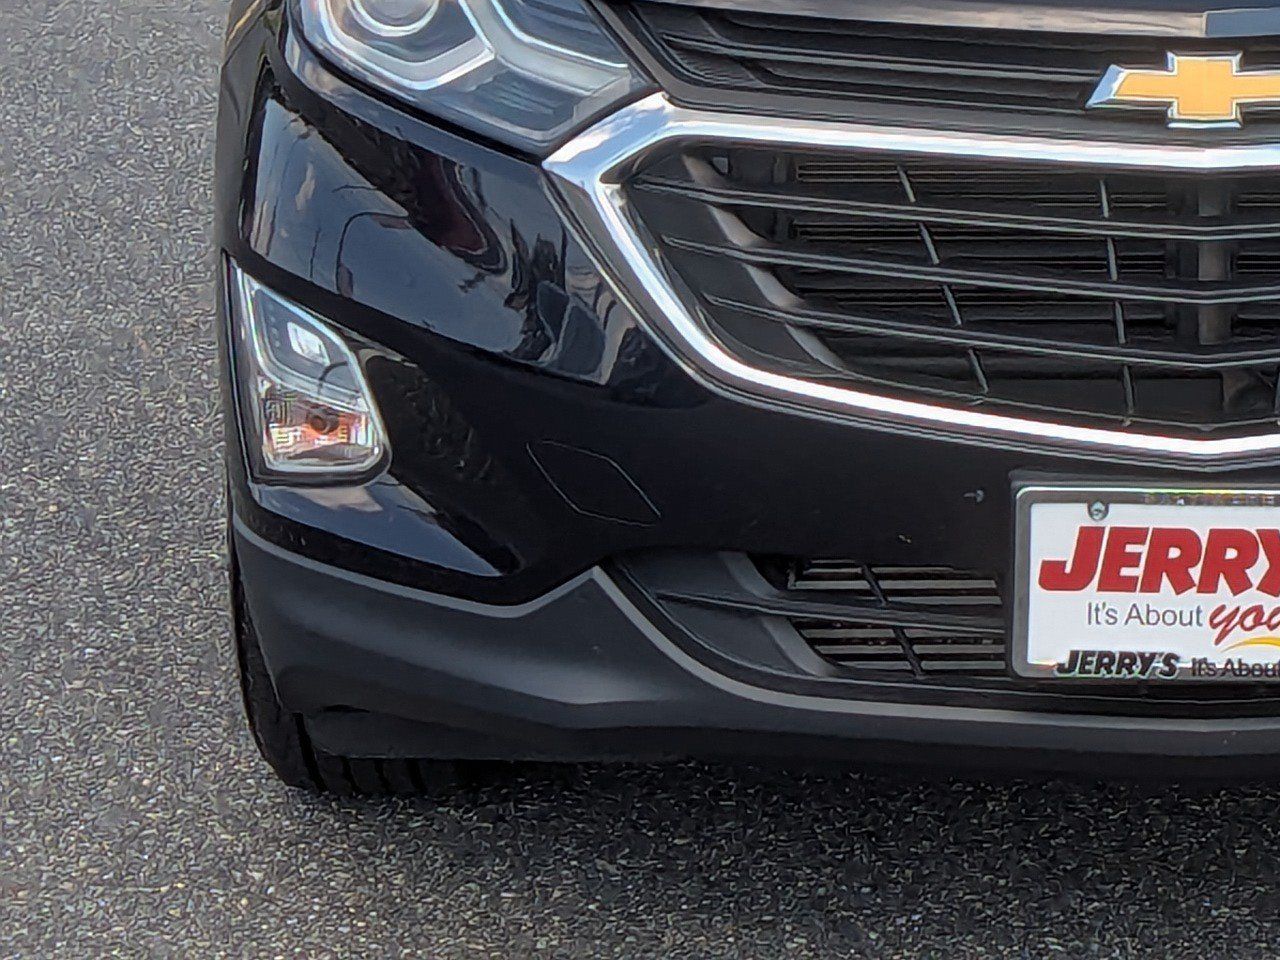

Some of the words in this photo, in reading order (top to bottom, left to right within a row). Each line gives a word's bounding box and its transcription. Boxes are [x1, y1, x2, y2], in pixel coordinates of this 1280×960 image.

[1086, 602, 1118, 626] It's
[1124, 602, 1203, 627] About
[1056, 650, 1181, 677] JERRY'S
[1192, 657, 1217, 677] It's
